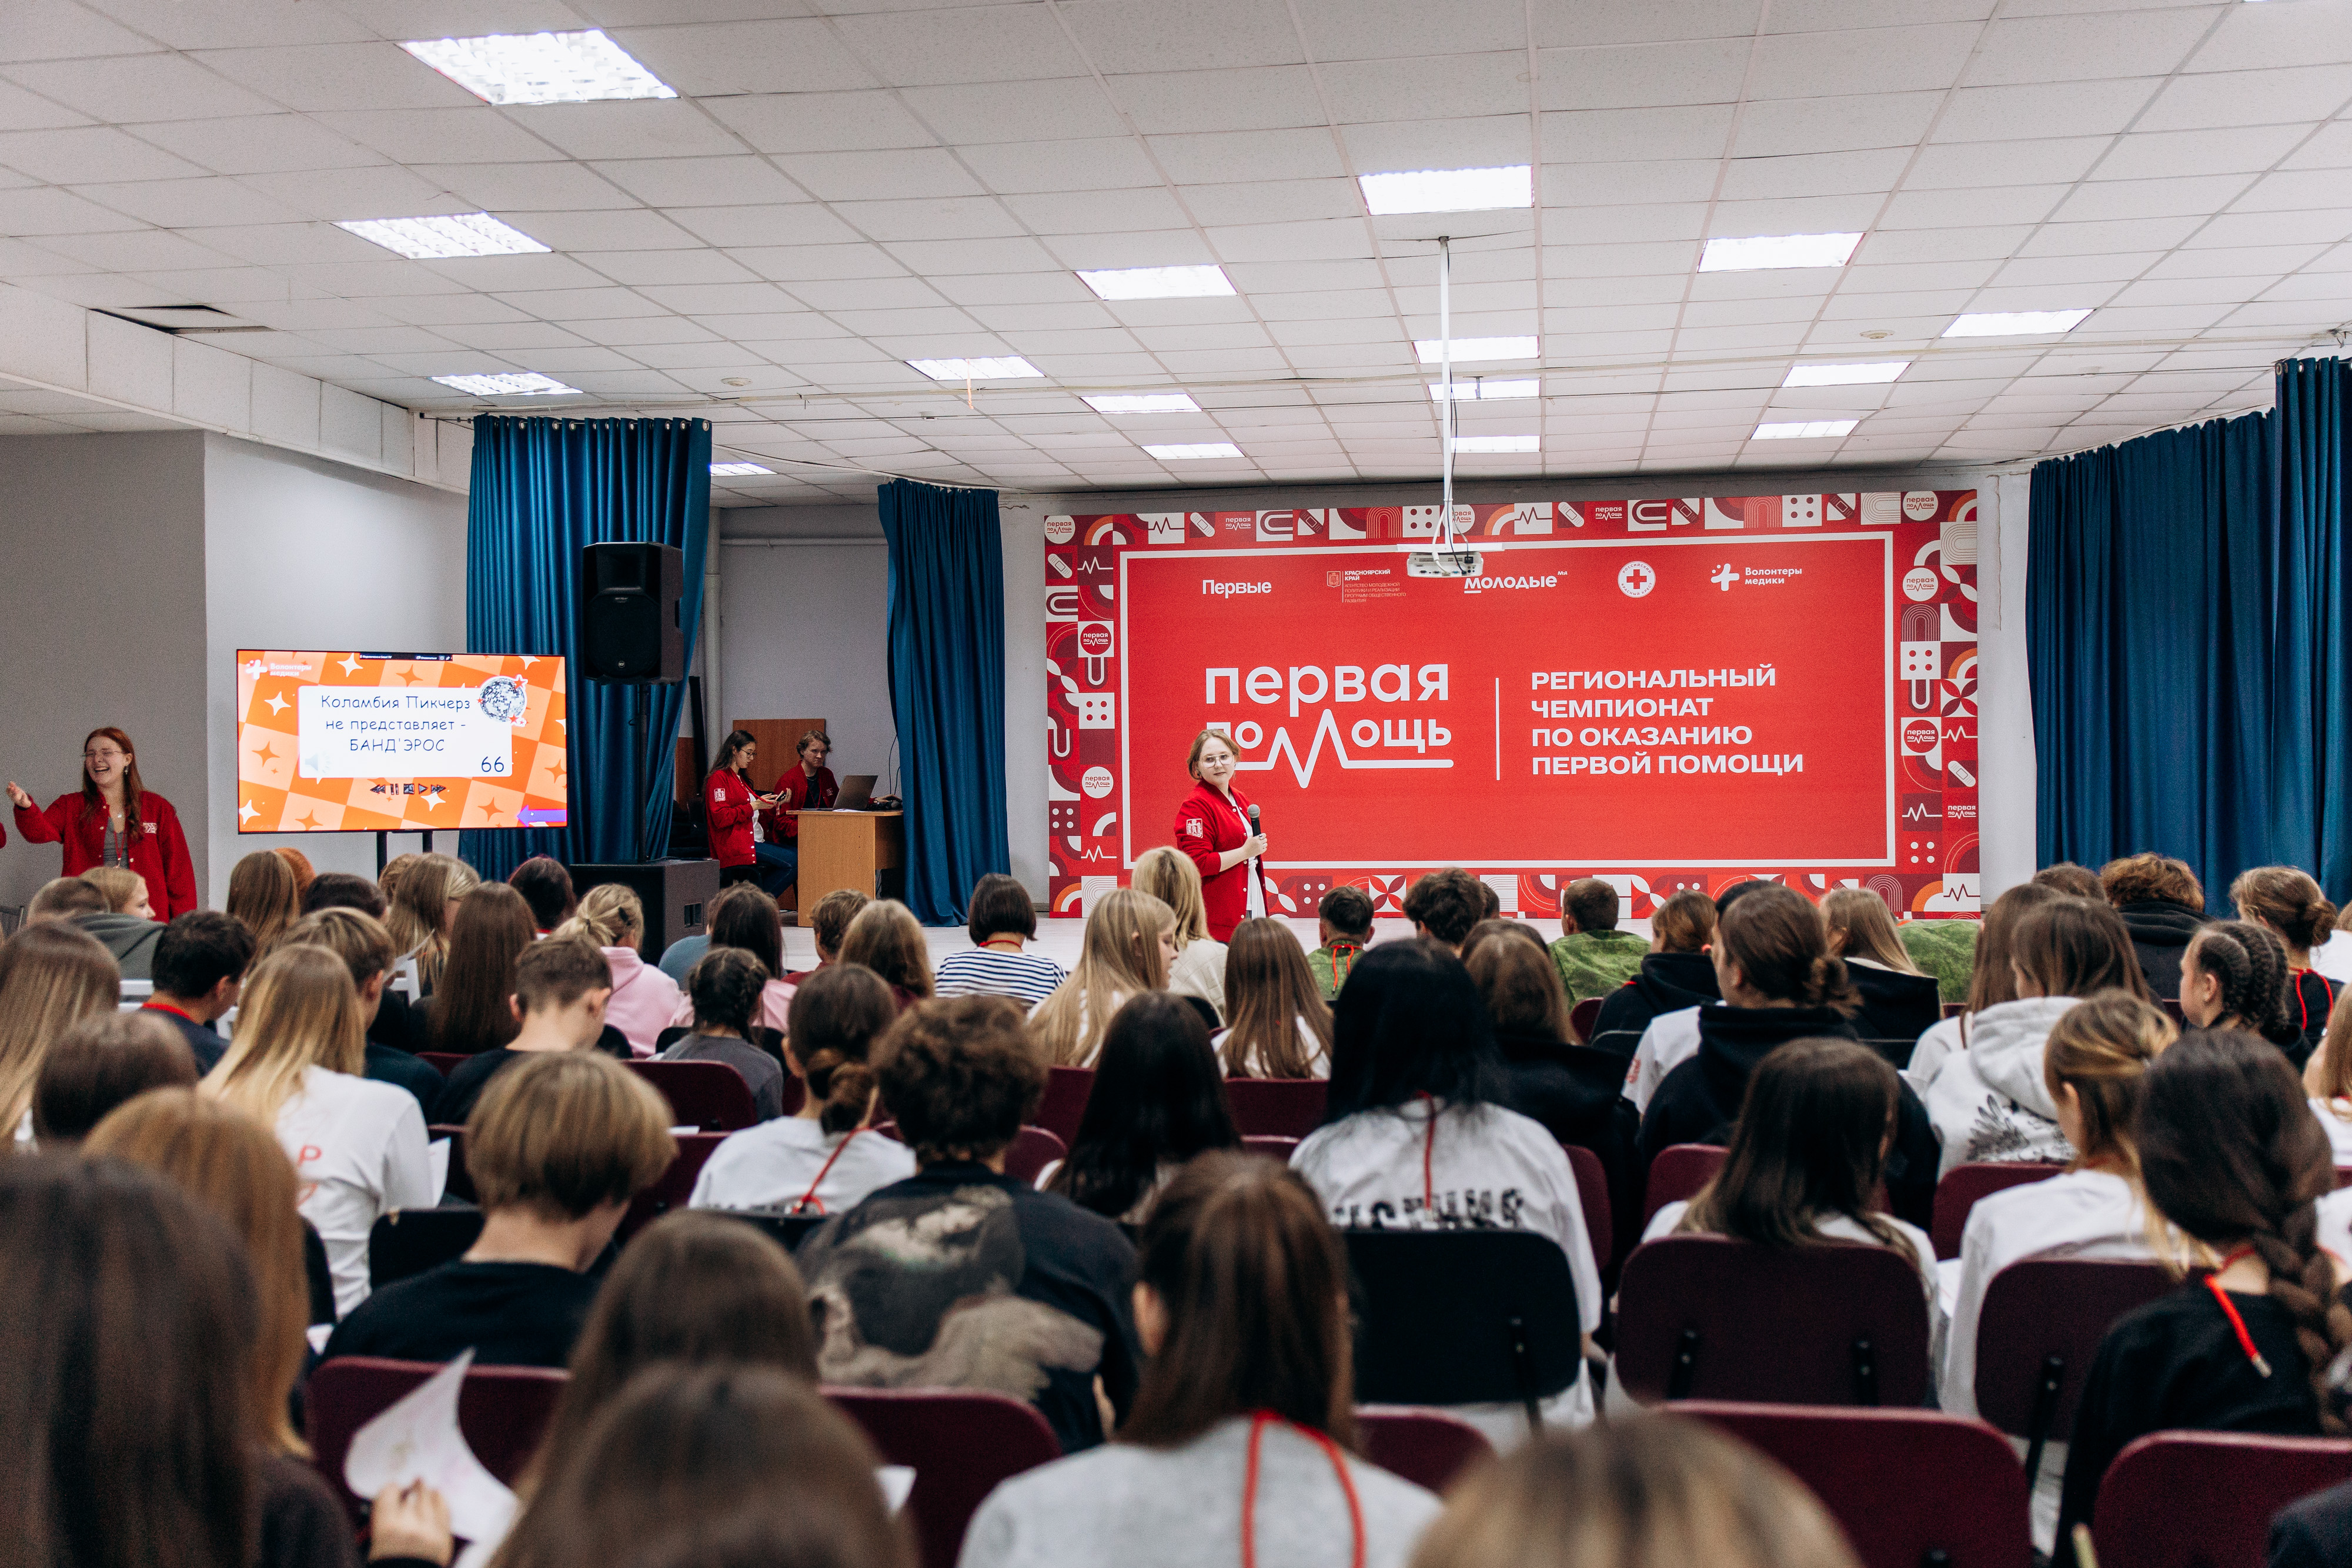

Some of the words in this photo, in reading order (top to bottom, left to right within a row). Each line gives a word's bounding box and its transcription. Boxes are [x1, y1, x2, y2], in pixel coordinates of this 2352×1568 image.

[1623, 563, 1652, 574] РОССИЙСКИЙ
[1745, 567, 1803, 577] Волонтеры
[1202, 579, 1272, 599] Первые
[1464, 576, 1558, 590] молодые
[1621, 583, 1641, 596] КРАСНЫЙ
[1641, 582, 1653, 594] КРЕСТ
[1745, 577, 1785, 586] медики
[270, 663, 312, 671] Волонтеры
[1532, 664, 1776, 690] РЕГИОНАЛЬНЫЙ
[1205, 664, 1449, 717] первая
[322, 695, 400, 710] Коламбия
[406, 696, 470, 713] Пикчерз
[1532, 698, 1713, 718] ЧЕМПИОНАТ
[326, 720, 344, 731] не
[350, 718, 455, 734] представляет
[1532, 728, 1573, 747] ПО
[1579, 726, 1753, 746] ОКАЗАНИЮ
[350, 737, 445, 753] БАНД'ЭРОС
[481, 756, 505, 773] 66
[1532, 751, 1651, 775] ПЕРВОЙ
[1658, 754, 1803, 776] ПОМОЩИ
